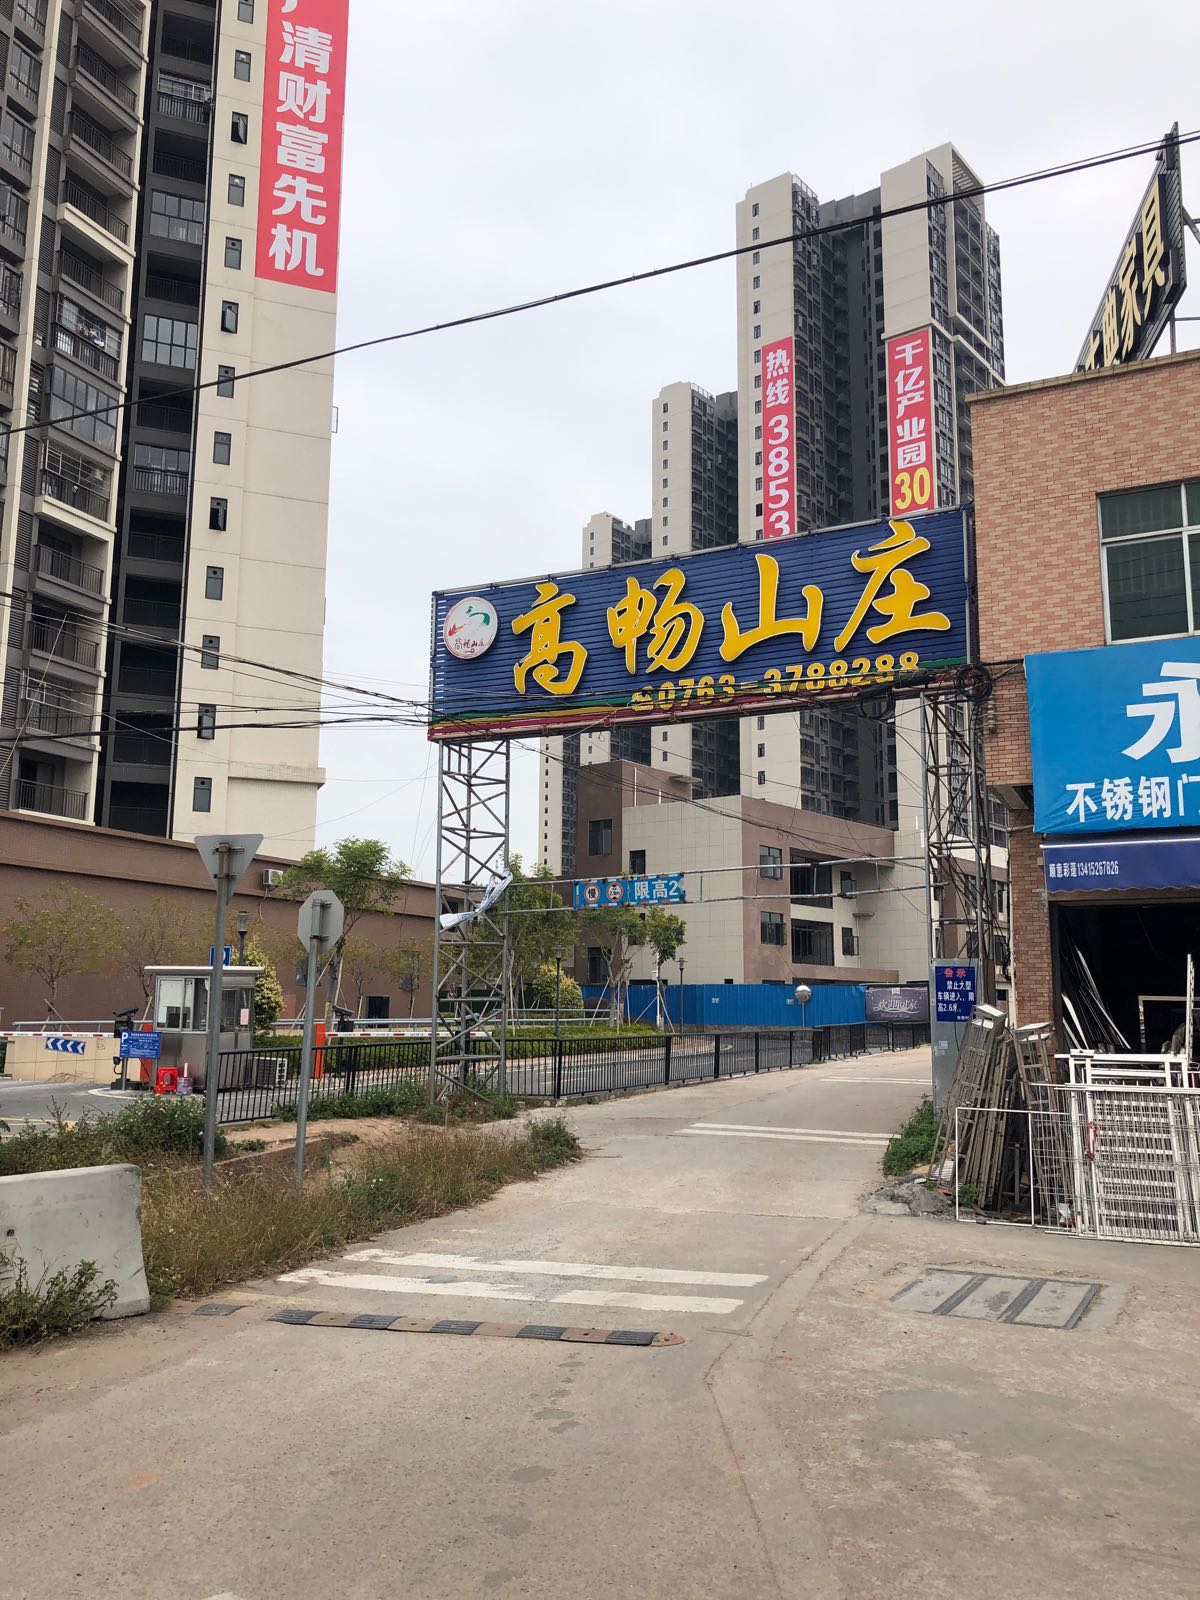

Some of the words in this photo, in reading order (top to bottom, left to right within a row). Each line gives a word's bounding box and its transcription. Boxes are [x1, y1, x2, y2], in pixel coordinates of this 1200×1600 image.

[894, 339, 931, 513] 千亿产业园30
[512, 520, 951, 696] 高畅山庄
